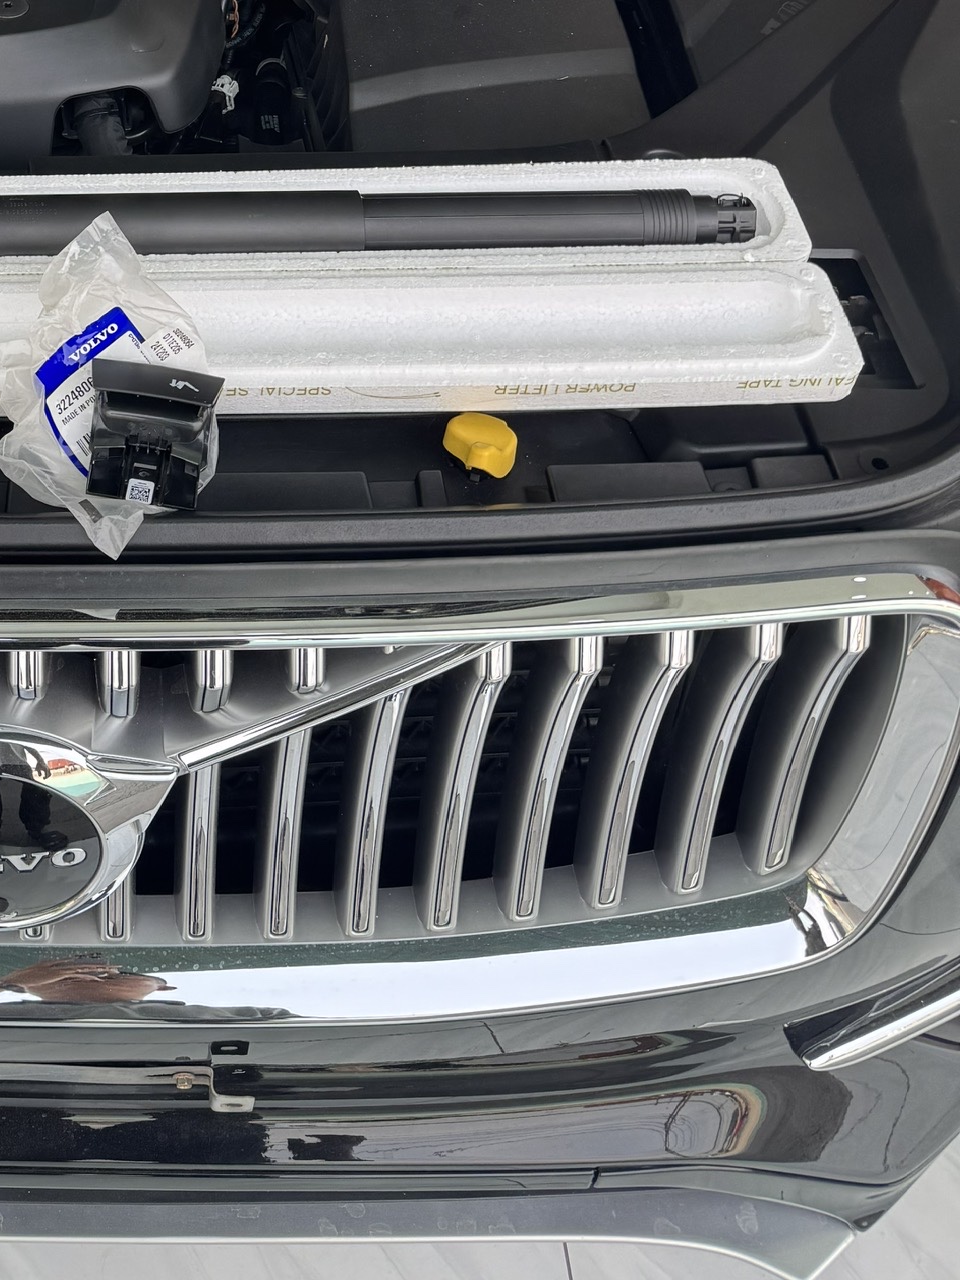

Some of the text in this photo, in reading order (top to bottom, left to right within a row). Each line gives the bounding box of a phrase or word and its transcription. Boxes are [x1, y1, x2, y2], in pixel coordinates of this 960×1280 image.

[67, 322, 119, 363] VOLVO
[61, 409, 80, 426] MADE
[78, 403, 87, 413] IN
